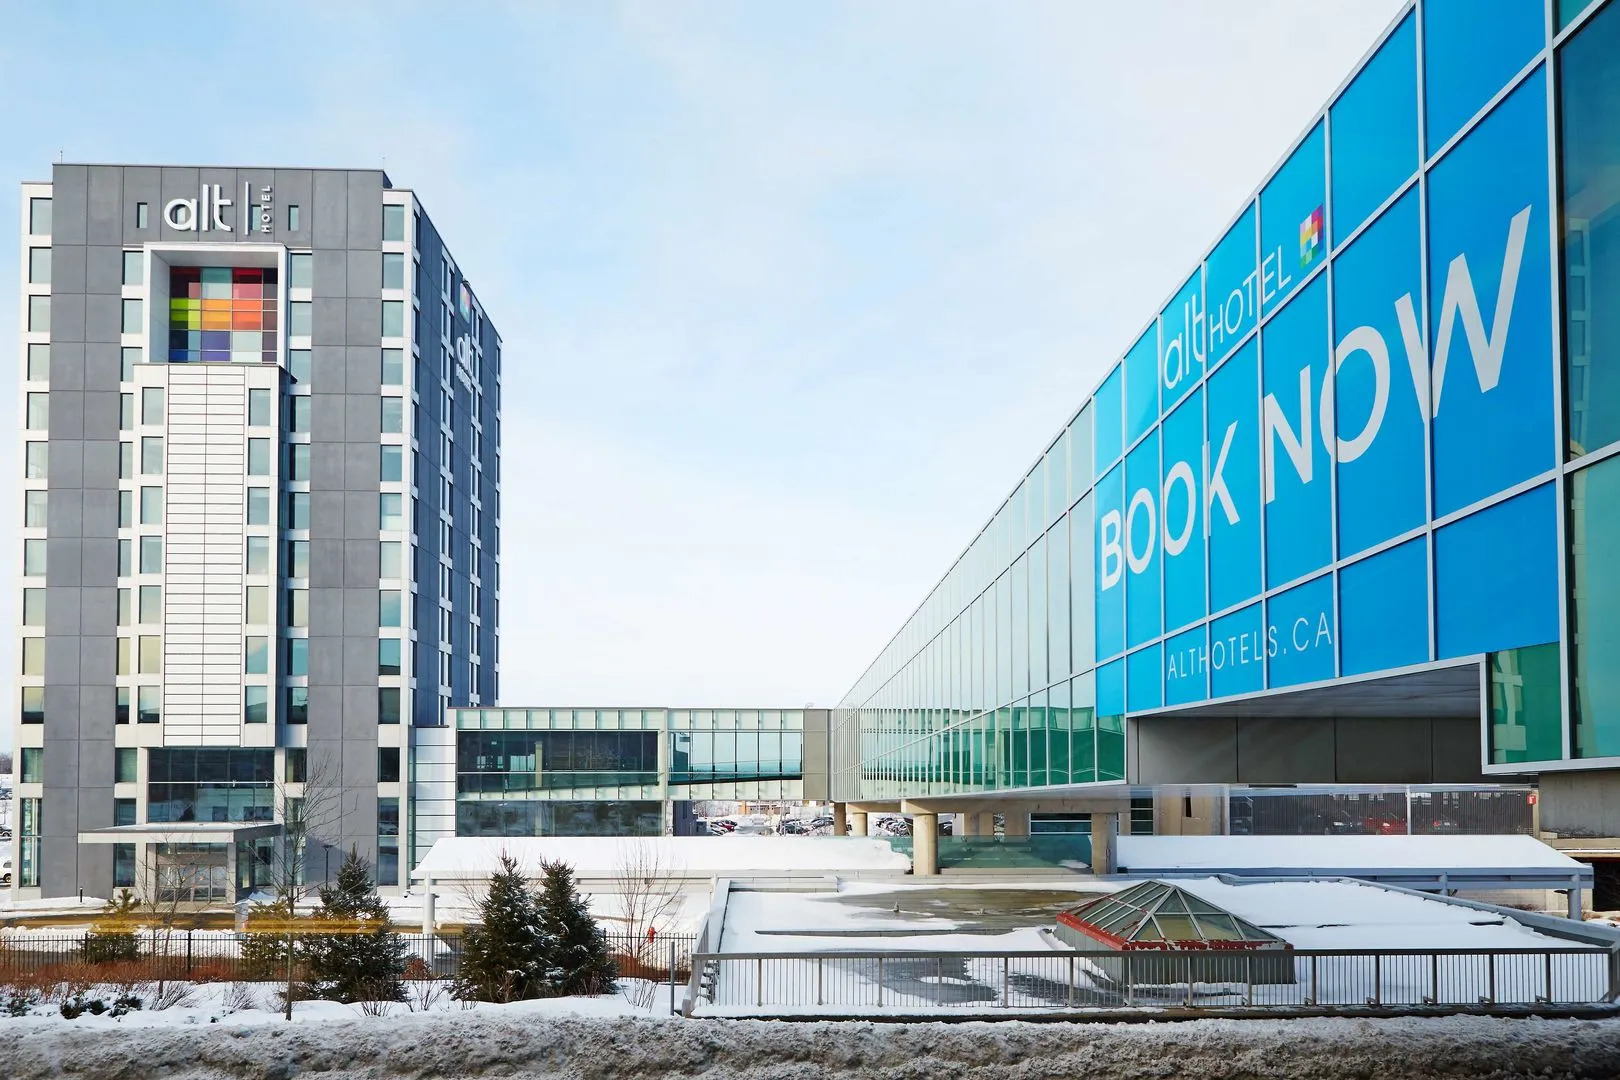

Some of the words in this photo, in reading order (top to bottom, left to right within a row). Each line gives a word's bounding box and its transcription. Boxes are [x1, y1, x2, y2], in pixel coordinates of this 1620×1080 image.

[163, 184, 232, 231] alt
[261, 185, 271, 233] HOTEL
[1163, 293, 1205, 390] alt
[1209, 244, 1292, 353] HOTEL
[1101, 420, 1241, 592] BOOK
[1263, 203, 1532, 505] NOW
[1167, 612, 1332, 681] ALTHOTELS.CA
